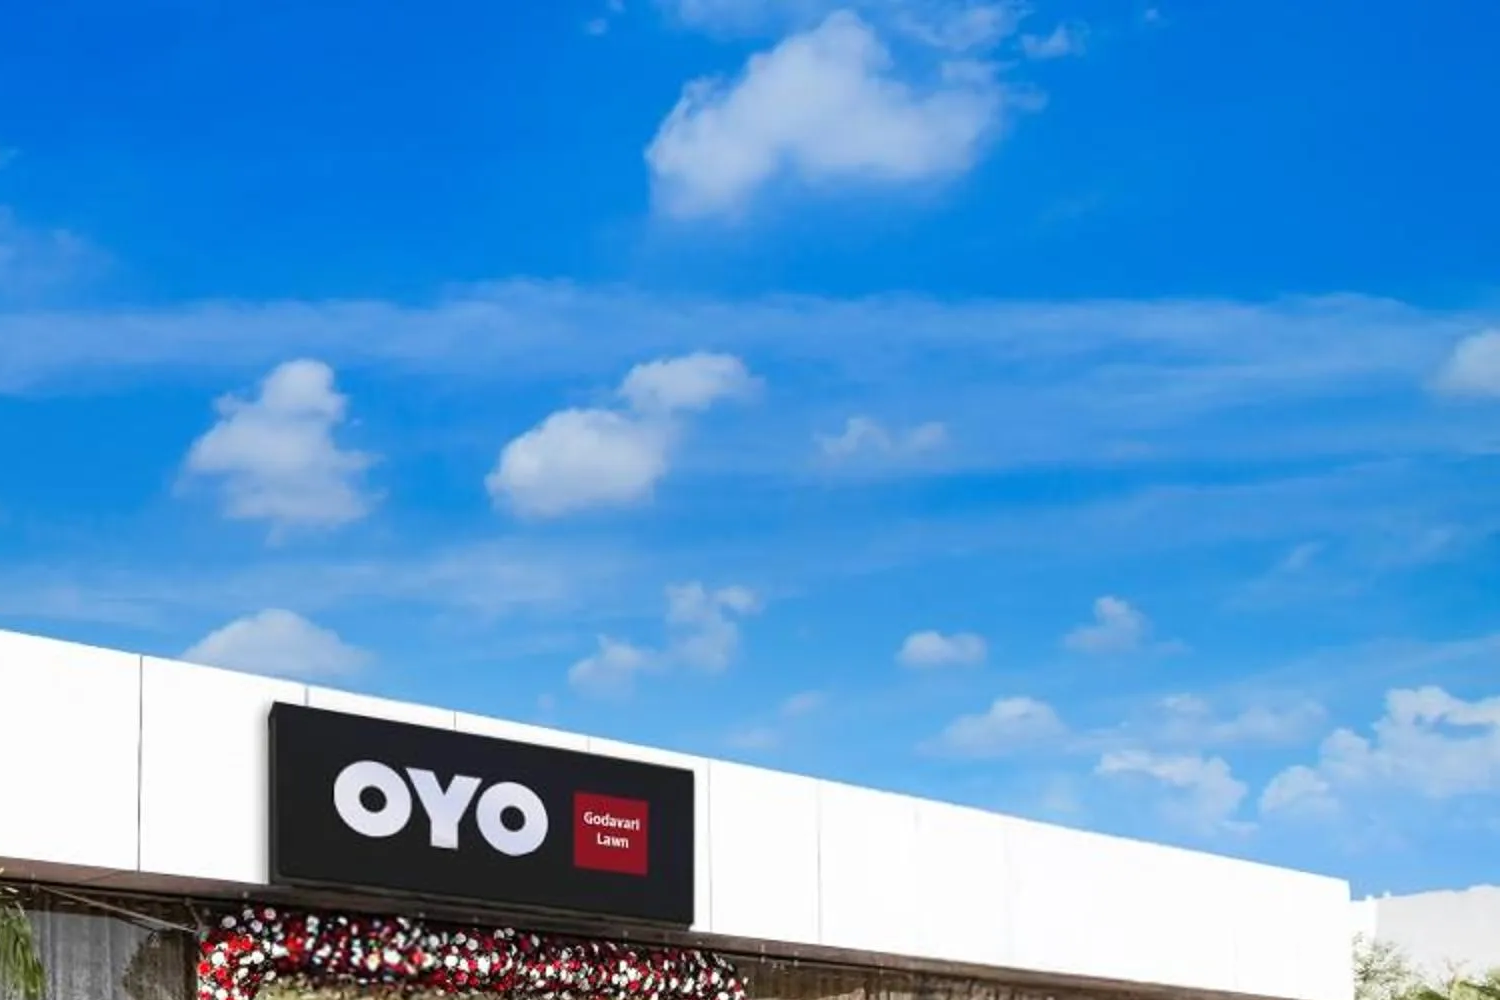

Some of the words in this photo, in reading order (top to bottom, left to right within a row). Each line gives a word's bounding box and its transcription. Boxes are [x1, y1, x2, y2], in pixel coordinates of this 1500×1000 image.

[333, 760, 549, 856] OYO
[583, 810, 640, 831] Godavari
[596, 832, 630, 849] Lawn
